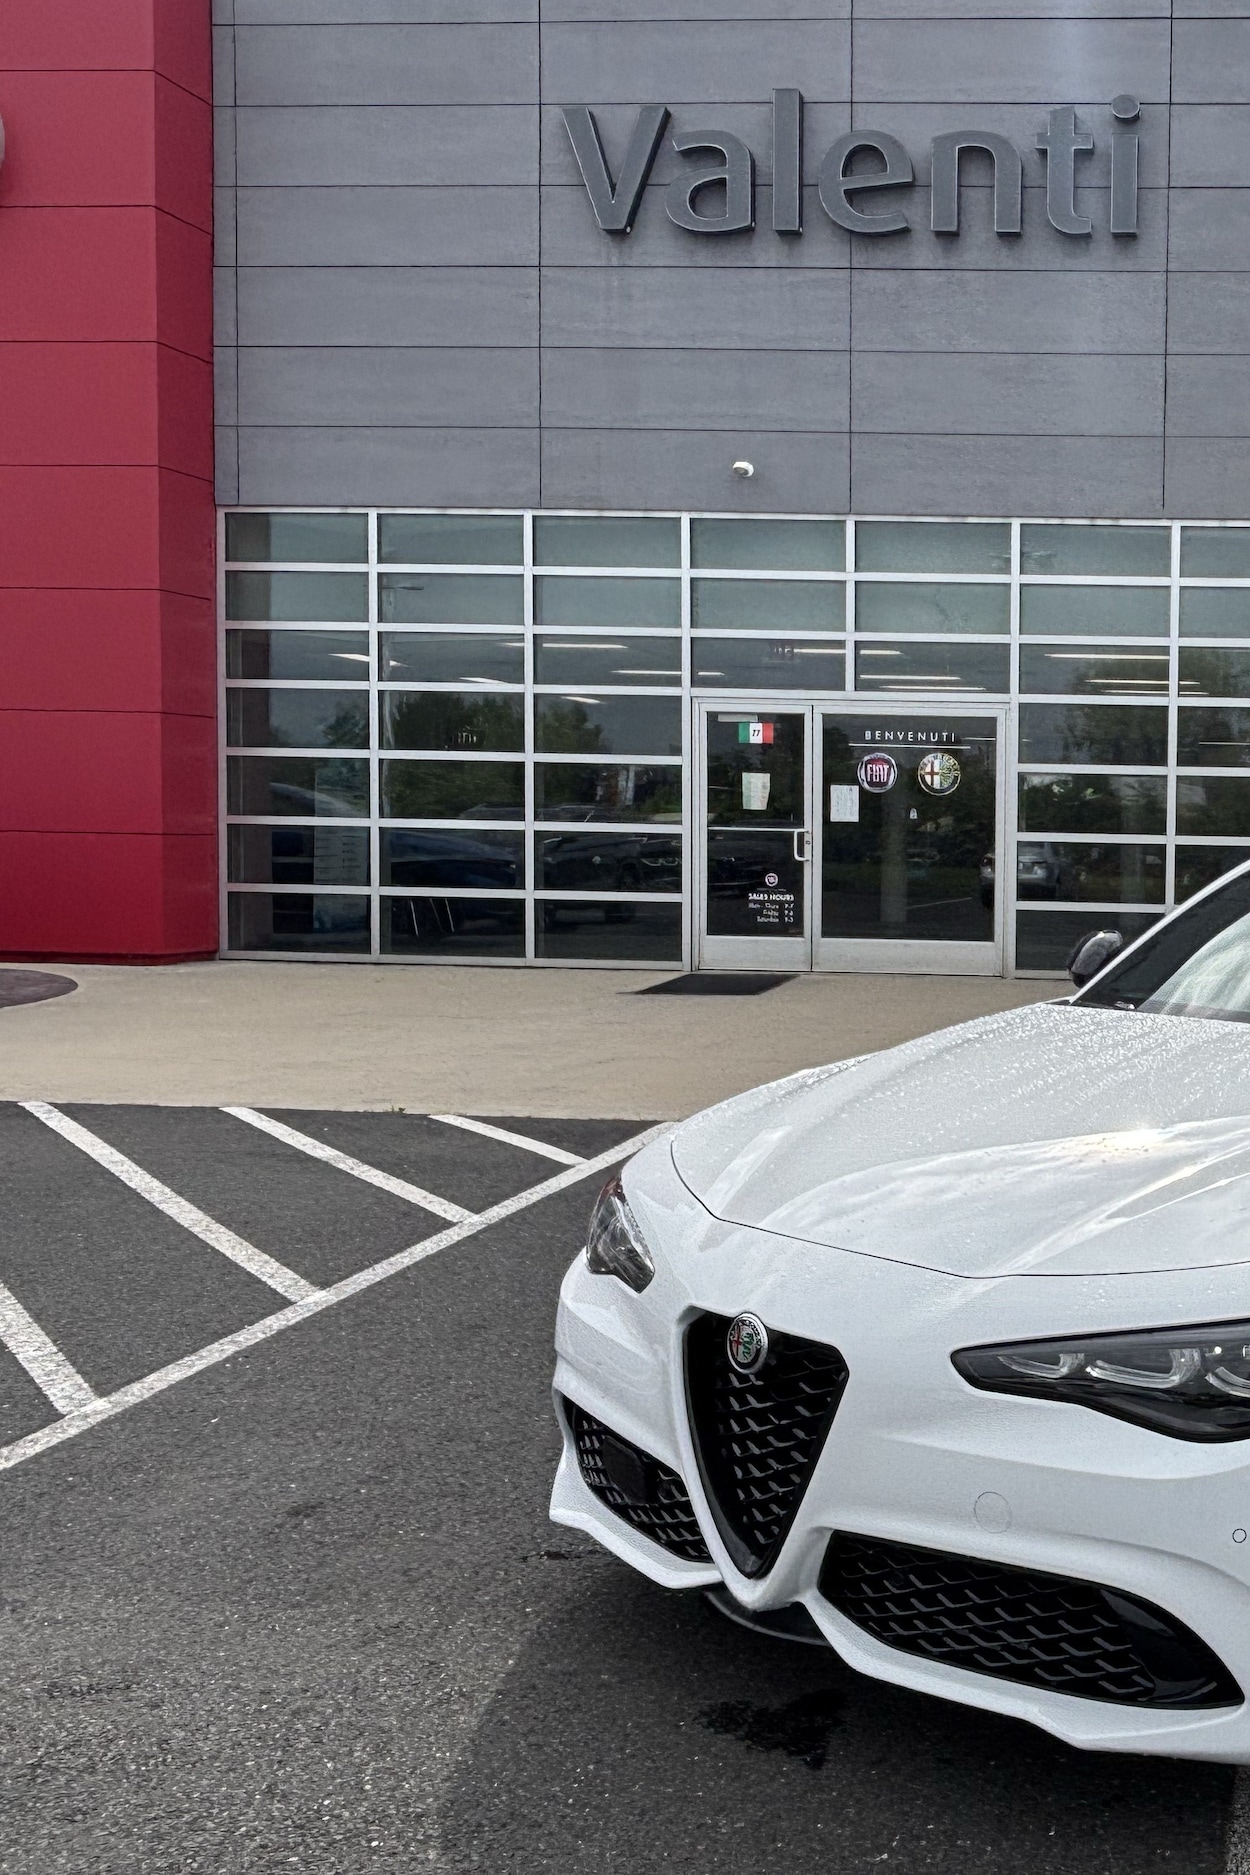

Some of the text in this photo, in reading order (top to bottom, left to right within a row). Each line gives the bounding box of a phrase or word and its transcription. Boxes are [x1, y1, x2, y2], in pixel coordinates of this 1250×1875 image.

[561, 88, 1142, 236] Valenti
[864, 730, 955, 743] BENVENUTI
[866, 763, 890, 783] FIAT
